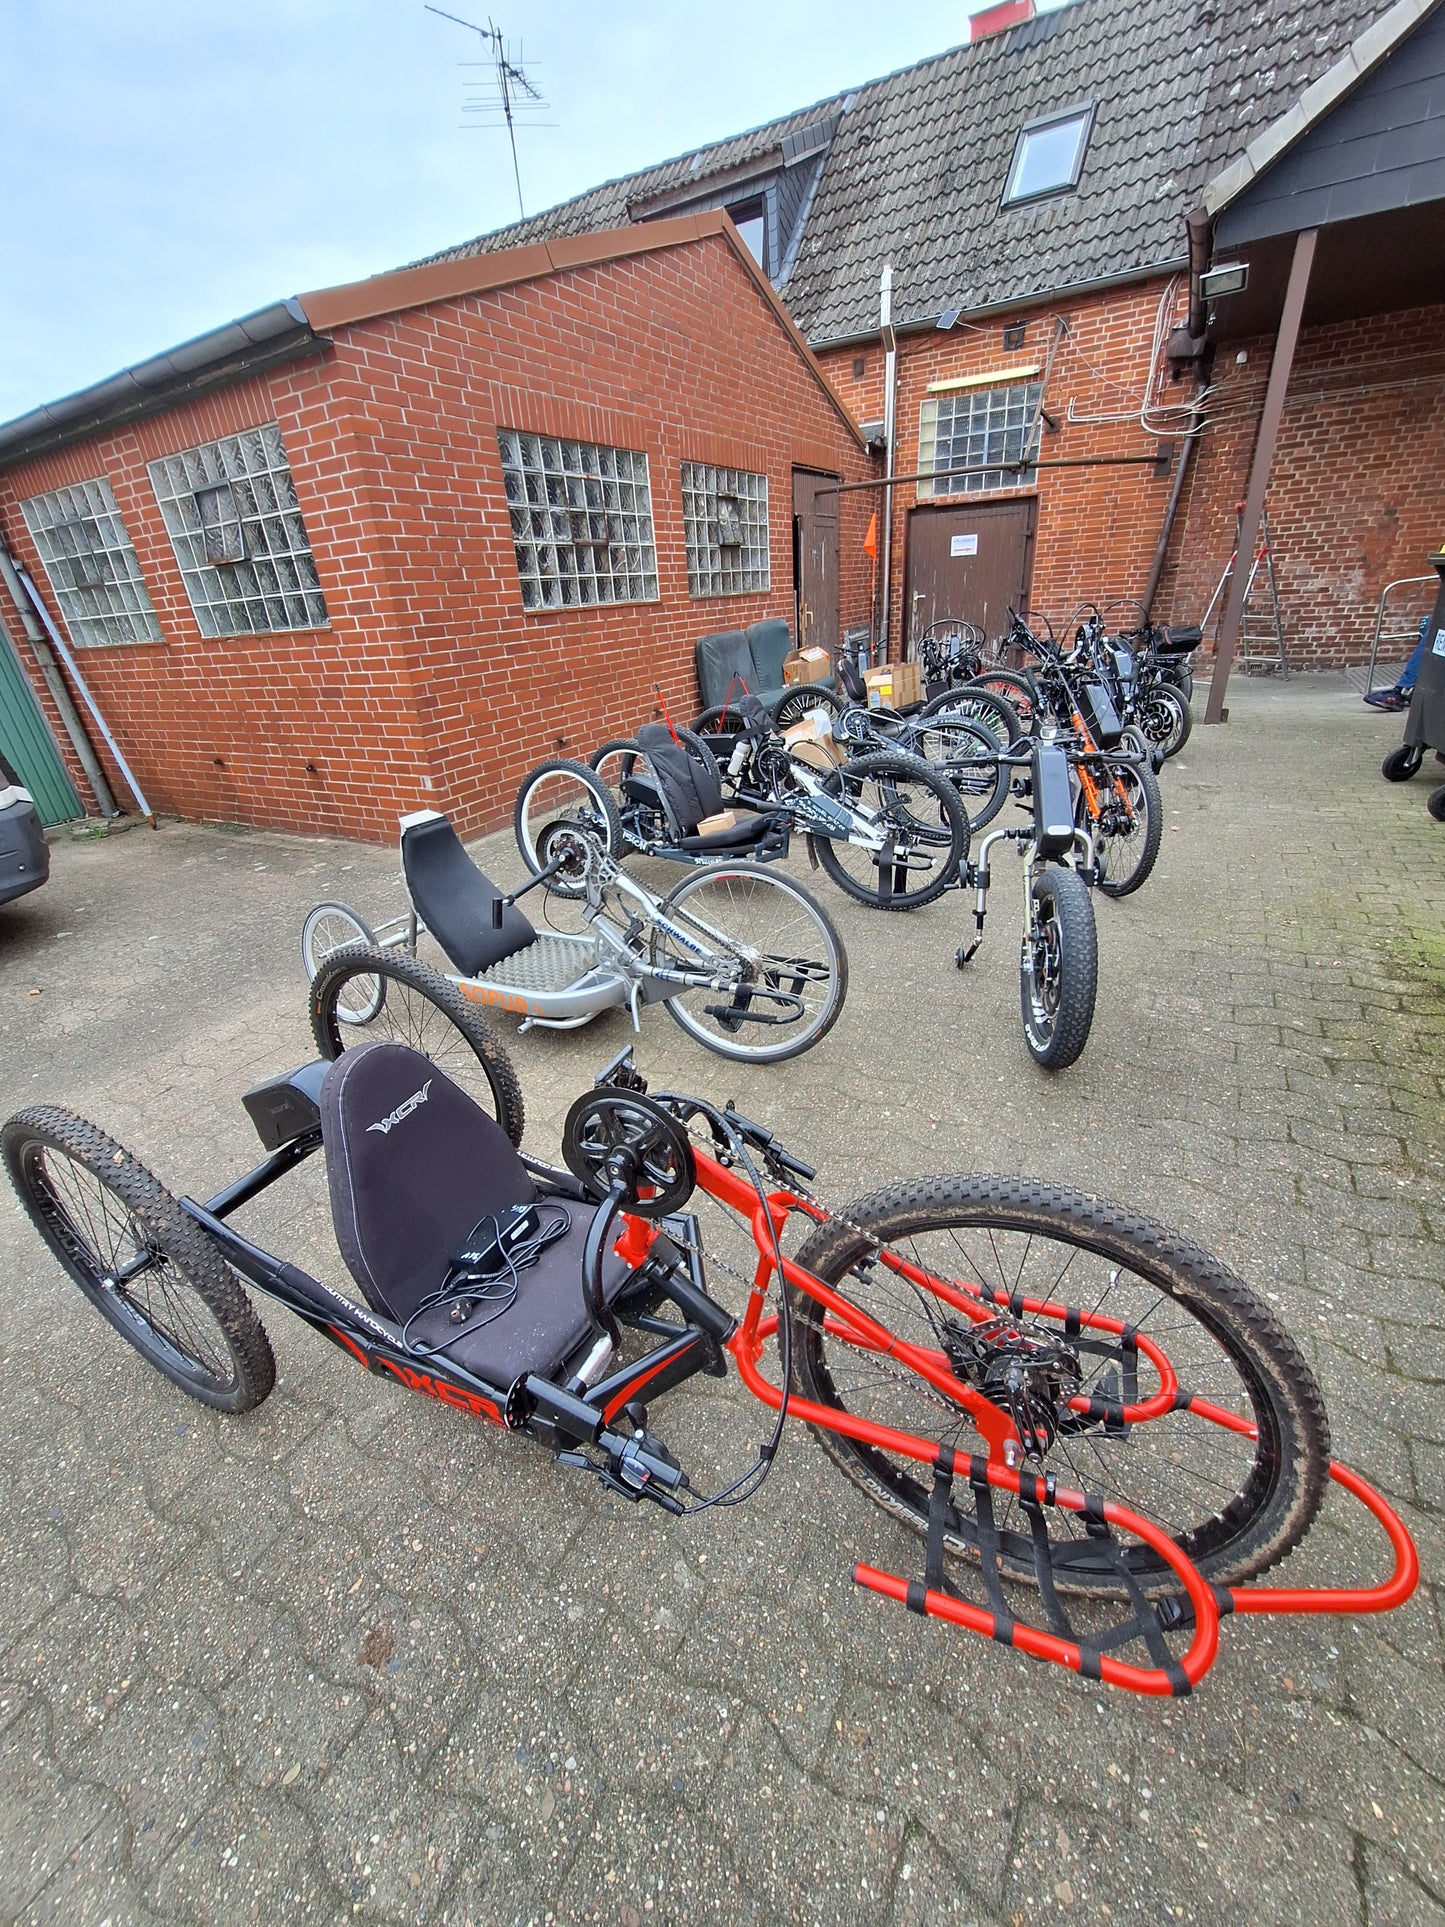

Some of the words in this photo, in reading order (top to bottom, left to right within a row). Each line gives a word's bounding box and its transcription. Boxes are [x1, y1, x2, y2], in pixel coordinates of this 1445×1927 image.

[656, 919, 702, 954] SCHWALBE
[459, 982, 528, 1016] SOPUR
[374, 1085, 429, 1133] XCR
[402, 1367, 507, 1428] XCR
